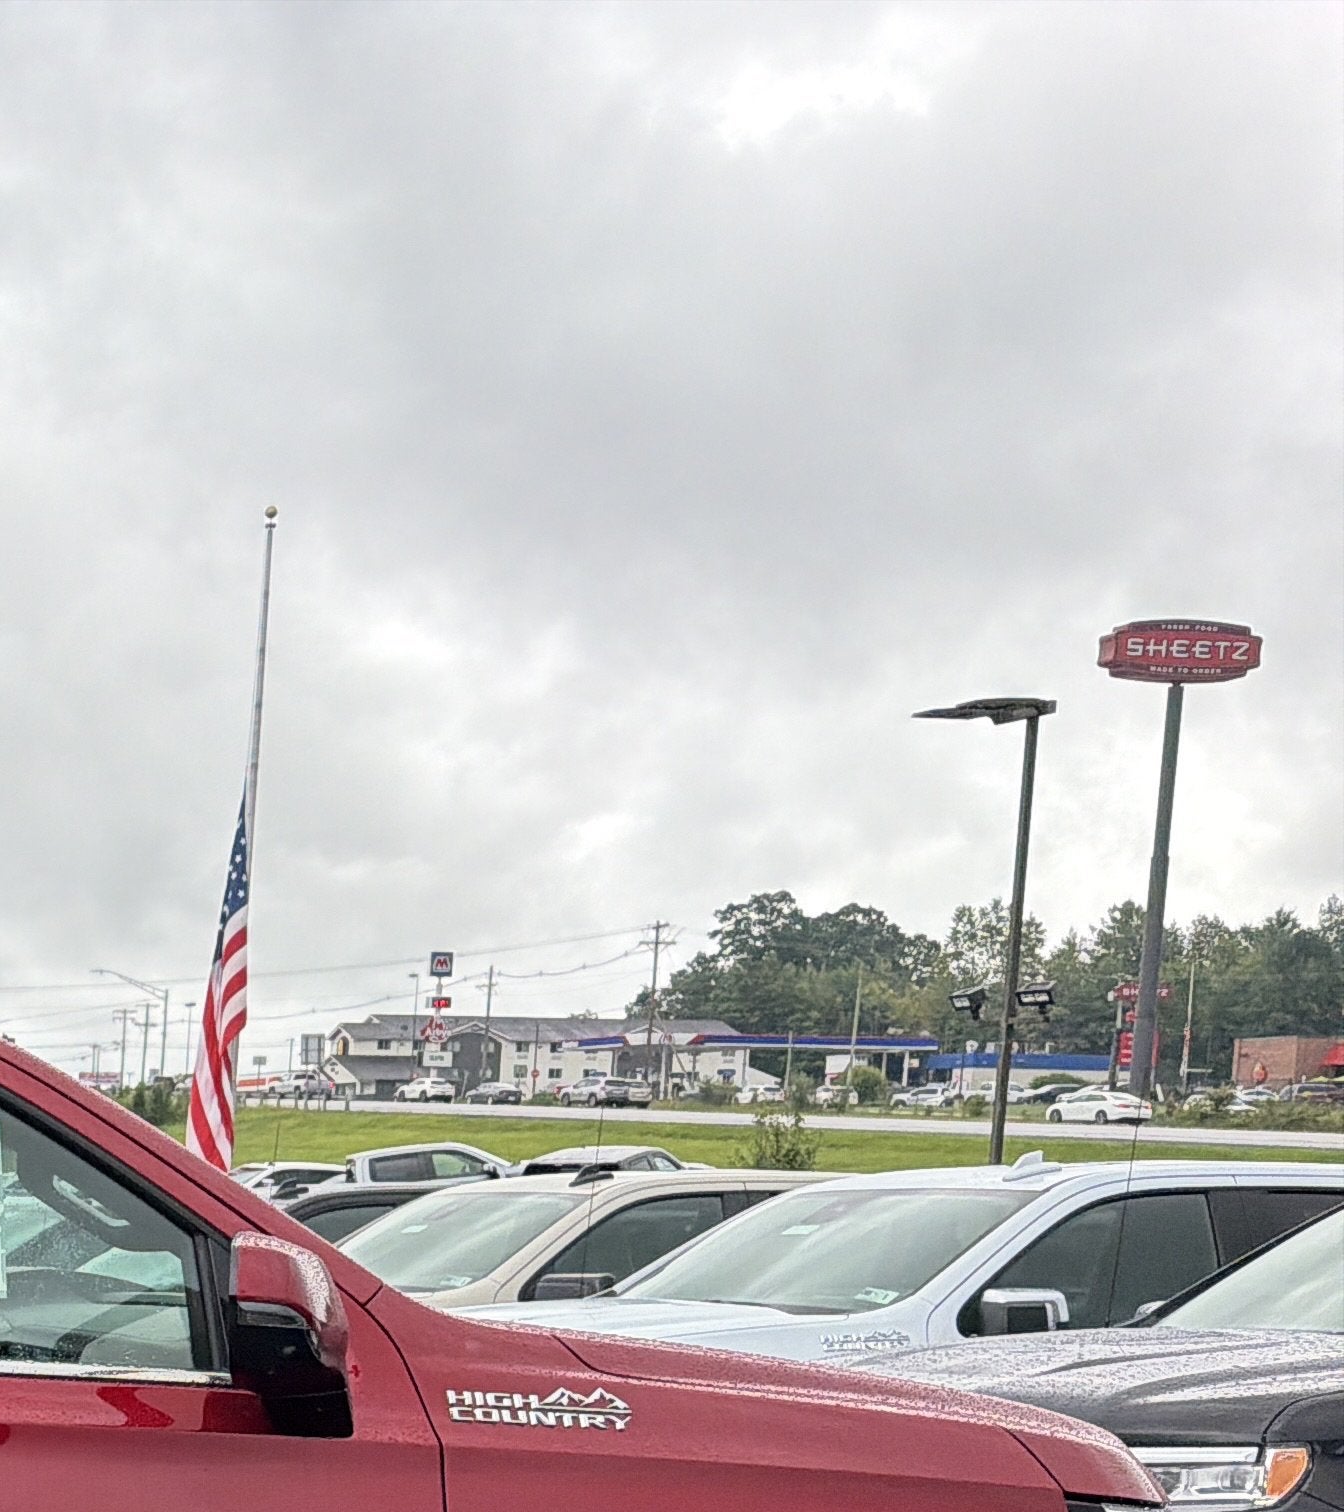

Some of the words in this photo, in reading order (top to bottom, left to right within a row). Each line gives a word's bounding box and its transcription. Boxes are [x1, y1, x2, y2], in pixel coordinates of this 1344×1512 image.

[1126, 637, 1250, 660] SHEETZ
[445, 1389, 540, 1409] HIGH
[449, 1407, 633, 1430] COUNTRY
